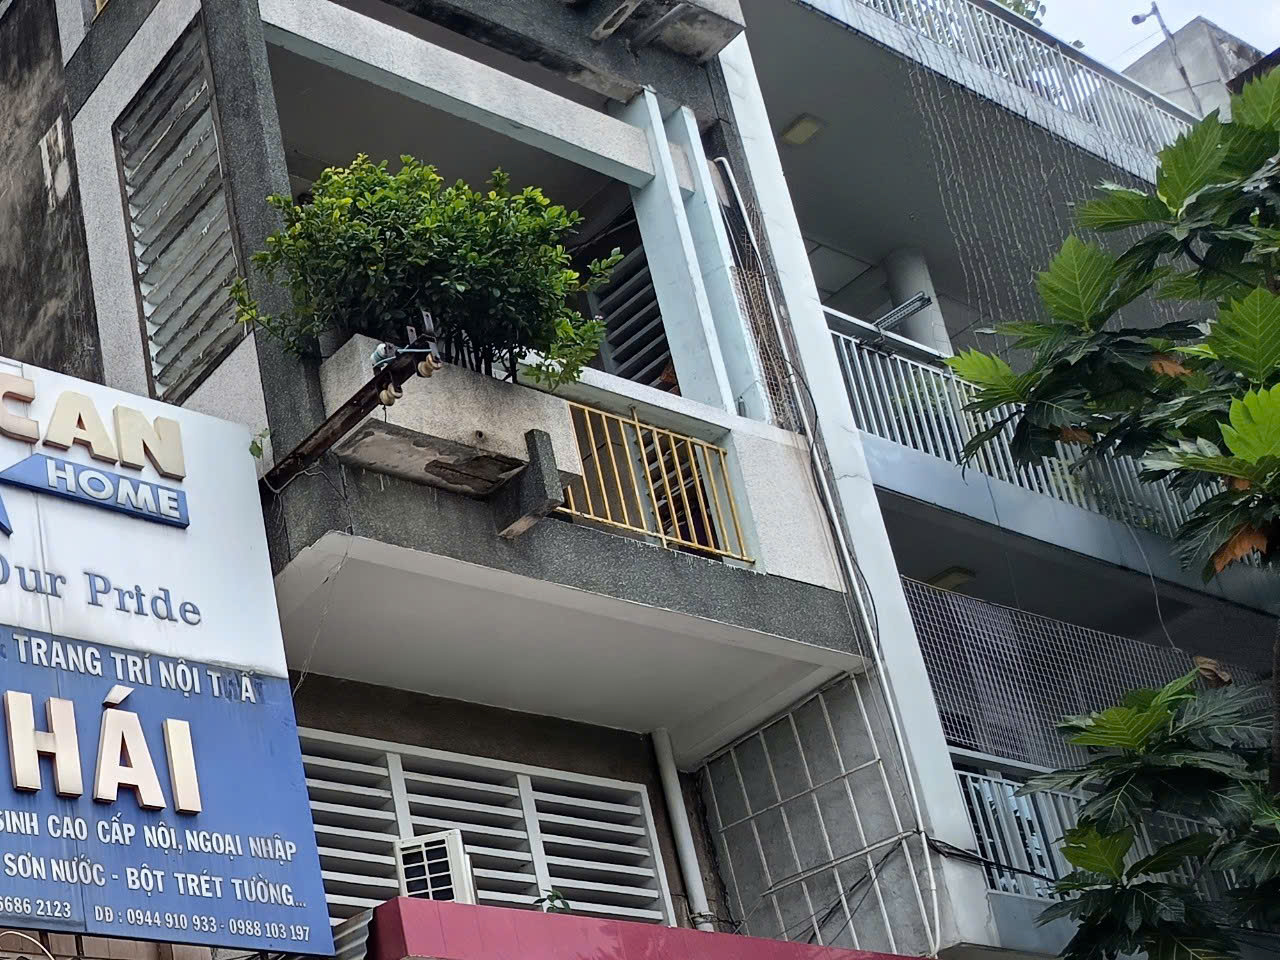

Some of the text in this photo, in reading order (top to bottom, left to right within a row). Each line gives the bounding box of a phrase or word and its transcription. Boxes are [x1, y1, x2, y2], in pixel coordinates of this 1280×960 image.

[46, 457, 182, 520] HOME
[83, 570, 202, 626] Pride
[13, 633, 102, 677] TRANG
[110, 650, 153, 688] TRÍ
[159, 658, 200, 696] NỘI
[206, 669, 264, 704] TẤ
[47, 814, 88, 841] CAO
[97, 813, 136, 846] CẤP
[185, 829, 242, 859] NGOẠI
[249, 833, 297, 867] NHẬP
[4, 853, 47, 881] SƠN
[52, 855, 106, 887] NƯỚC
[126, 864, 165, 897] BỘT
[174, 868, 223, 899] TRÉT
[36, 898, 71, 918] 2123
[127, 908, 162, 928] 0944
[165, 910, 188, 930] 910
[192, 913, 217, 933] 933
[228, 916, 261, 938] 0988
[265, 919, 287, 939] 103
[290, 921, 311, 942] 197
